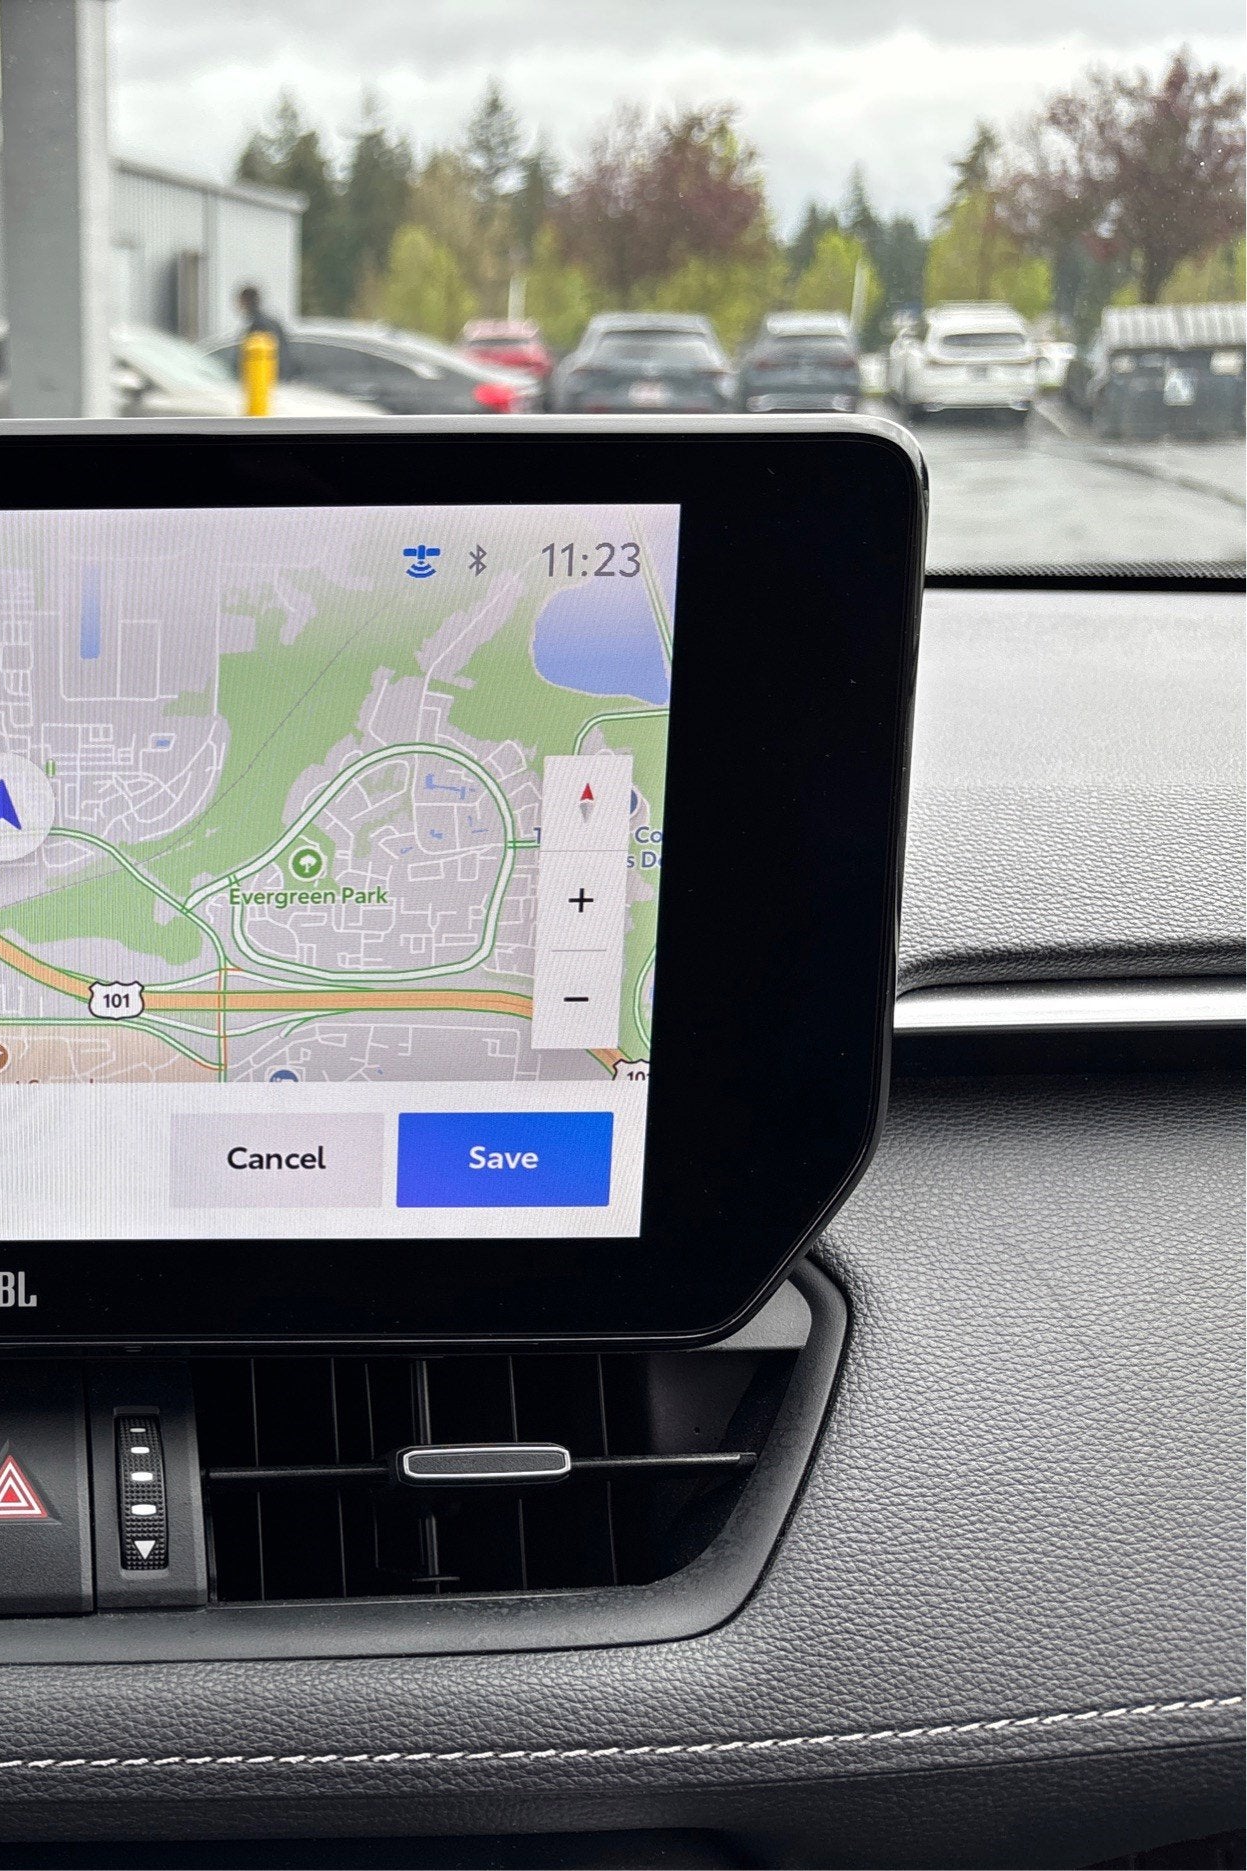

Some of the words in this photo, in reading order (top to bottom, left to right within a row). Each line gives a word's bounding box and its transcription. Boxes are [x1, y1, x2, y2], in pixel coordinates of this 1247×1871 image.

[541, 541, 642, 578] 11:23
[229, 887, 335, 908] Evergreen
[342, 886, 388, 905] Park
[102, 993, 131, 1009] 101
[227, 1146, 326, 1171] Cancel
[468, 1146, 539, 1170] Save
